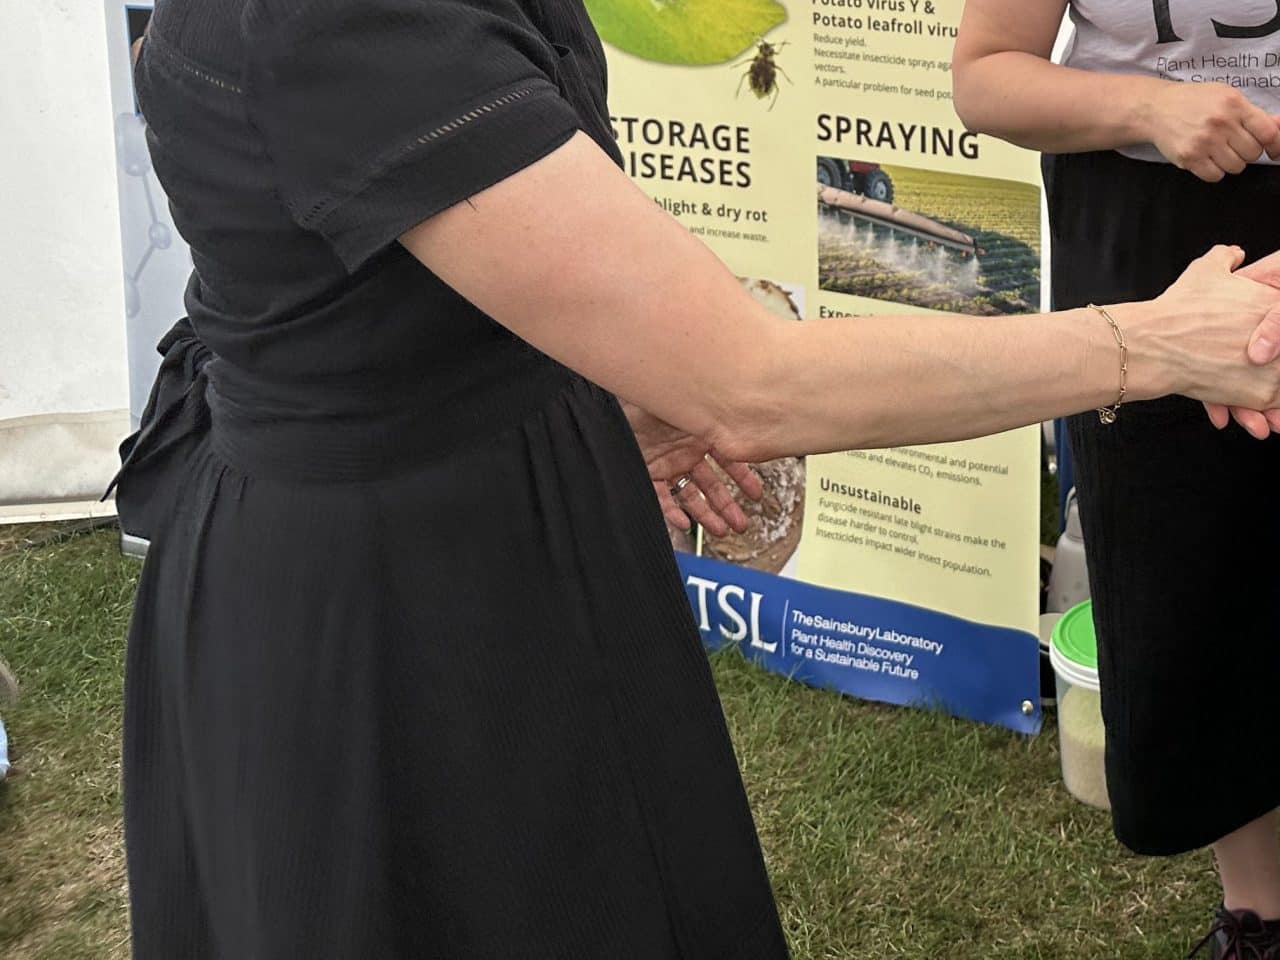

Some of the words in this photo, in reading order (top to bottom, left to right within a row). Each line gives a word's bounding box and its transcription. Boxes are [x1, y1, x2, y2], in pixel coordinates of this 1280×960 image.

[813, 12, 863, 29] Potato
[868, 16, 923, 35] leafroll
[909, 0, 920, 13] Y
[924, 0, 935, 15] &
[1201, 53, 1259, 69] Health
[817, 114, 979, 160] SPRAYING
[630, 152, 751, 188] ISEASES
[702, 202, 712, 216] &
[717, 204, 741, 222] dry
[746, 210, 768, 223] rot
[820, 477, 922, 514] Unsustainable
[936, 471, 983, 487] emissions.
[991, 537, 1006, 549] the
[687, 575, 778, 653] TSL
[792, 610, 944, 654] TheSainsburyLaboratory
[791, 629, 819, 646] Plant
[820, 635, 856, 652] Health
[857, 642, 914, 665] Discovery
[791, 642, 804, 656] for
[806, 649, 813, 659] a
[815, 651, 880, 672] Sustainable
[881, 662, 919, 680] Future
